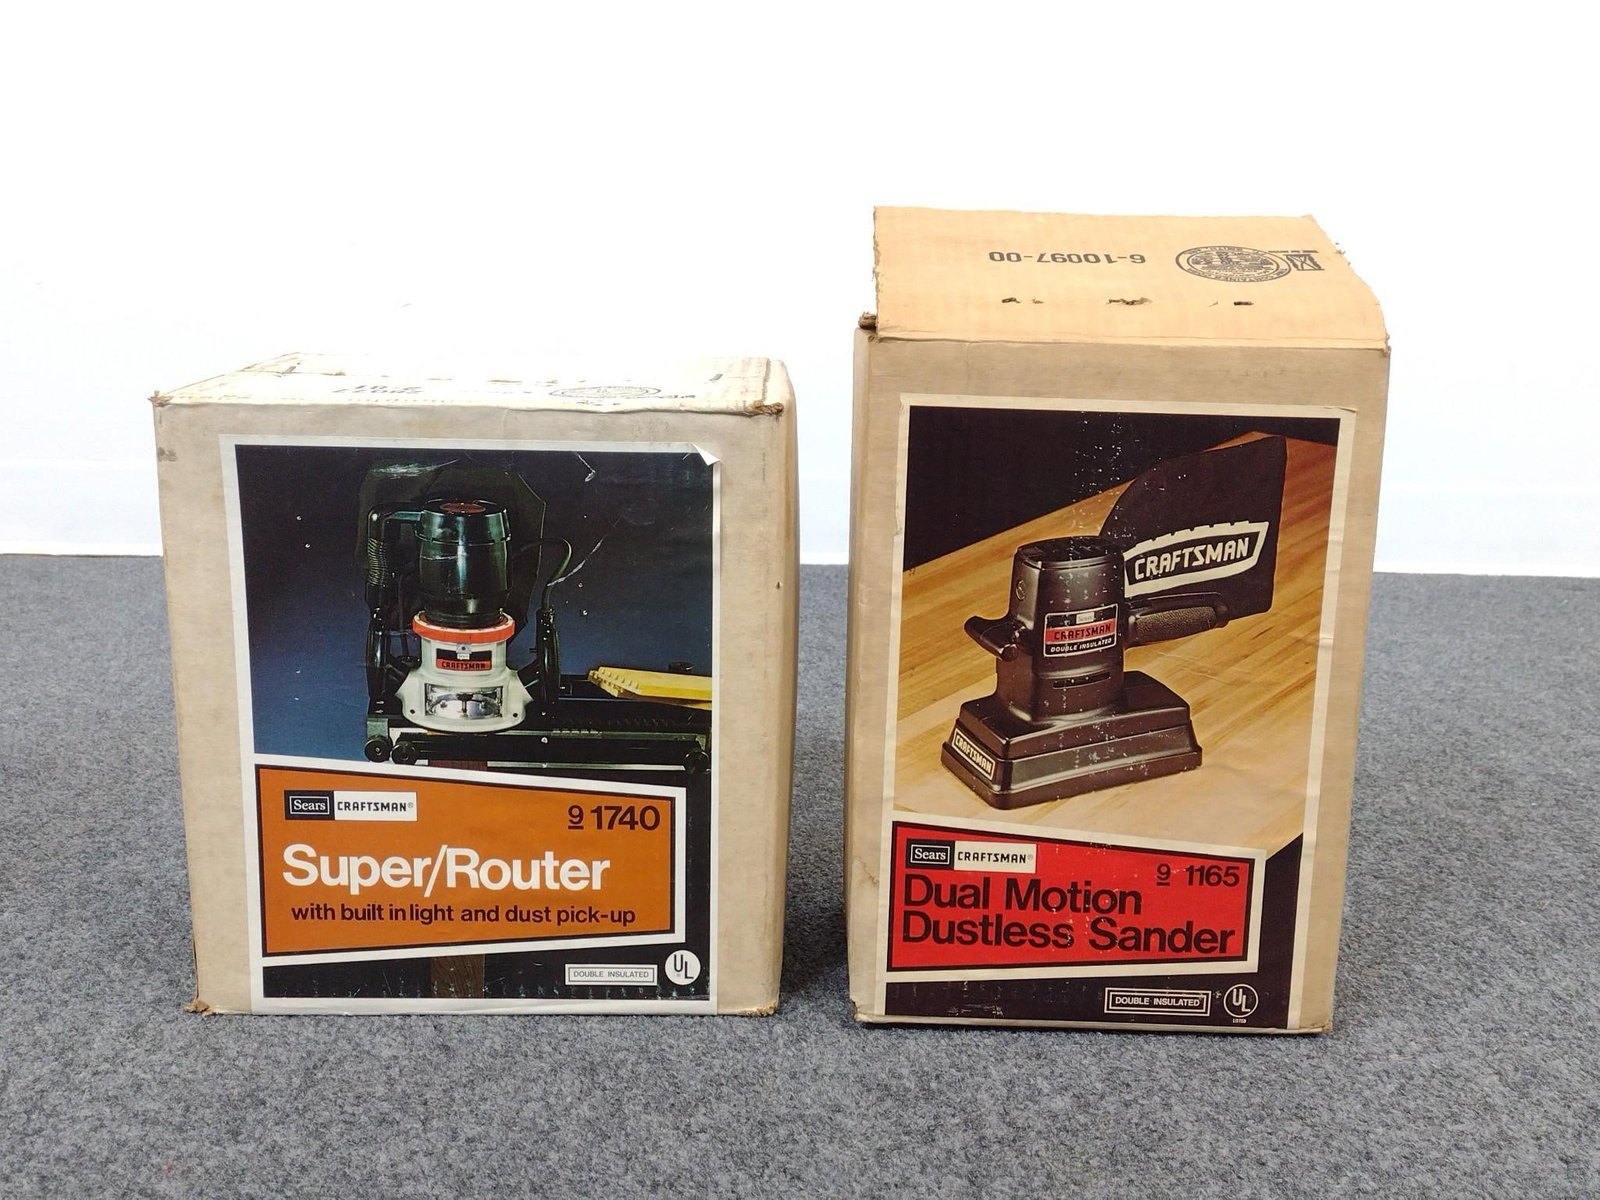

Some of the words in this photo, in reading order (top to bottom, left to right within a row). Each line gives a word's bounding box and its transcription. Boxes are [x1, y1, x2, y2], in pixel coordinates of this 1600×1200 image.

[988, 251, 1146, 264] 6-10097-00
[1134, 537, 1250, 580] CRAFTSMAN
[1054, 623, 1112, 640] CRAFTSMAN
[1050, 644, 1078, 653] DOUBLE
[1079, 637, 1112, 650] INSULATED
[441, 661, 486, 670] CRAFTSMAN
[955, 734, 992, 774] CRAFTSMAN
[293, 799, 326, 811] Sears
[568, 805, 584, 831] 9
[590, 805, 661, 831] 1740
[914, 848, 946, 861] Sears
[282, 843, 611, 898] Super/Router
[1156, 862, 1172, 887] 9
[1186, 864, 1241, 887] 1165
[903, 873, 990, 909] Dual
[1005, 878, 1143, 915] Motion
[291, 904, 336, 921] with
[340, 904, 384, 921] built
[388, 905, 406, 921] in
[409, 905, 454, 926] light
[460, 906, 500, 922] and
[504, 906, 552, 923] dust
[556, 907, 636, 926] pick-up
[902, 910, 1075, 948] Dustless
[1088, 917, 1236, 954] Sander
[607, 971, 649, 979] INSULATED
[1115, 997, 1149, 1005] DOUBLE
[1153, 998, 1200, 1007] INSULATED
